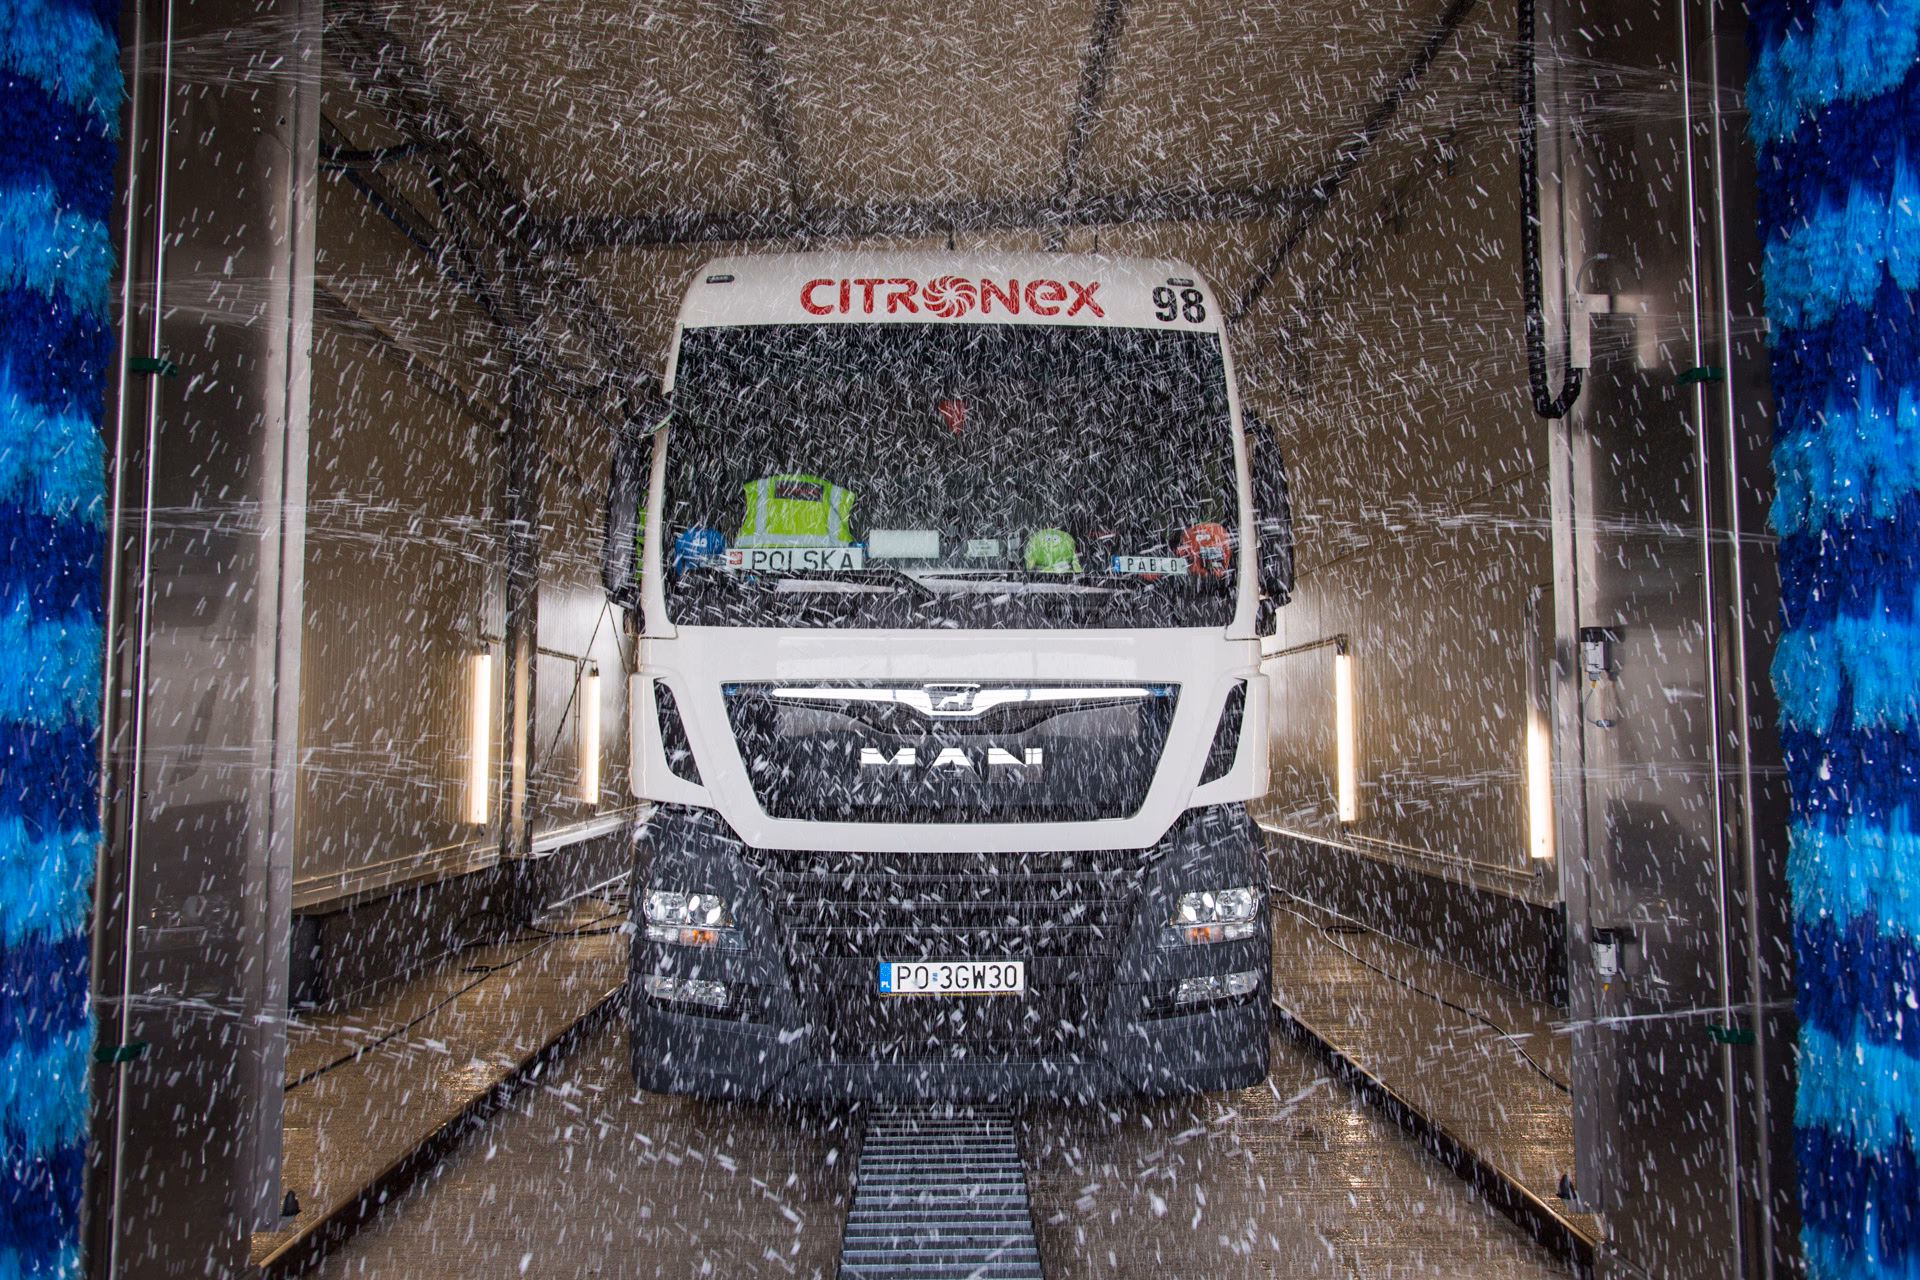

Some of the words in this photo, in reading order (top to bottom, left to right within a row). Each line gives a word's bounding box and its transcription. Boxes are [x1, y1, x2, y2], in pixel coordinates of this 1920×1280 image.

[1152, 285, 1206, 324] 98
[751, 549, 854, 571] POLSKA
[1127, 558, 1177, 573] PABLO
[860, 747, 1043, 783] MAN
[897, 965, 929, 989] PO
[940, 964, 1017, 989] 3GW30
